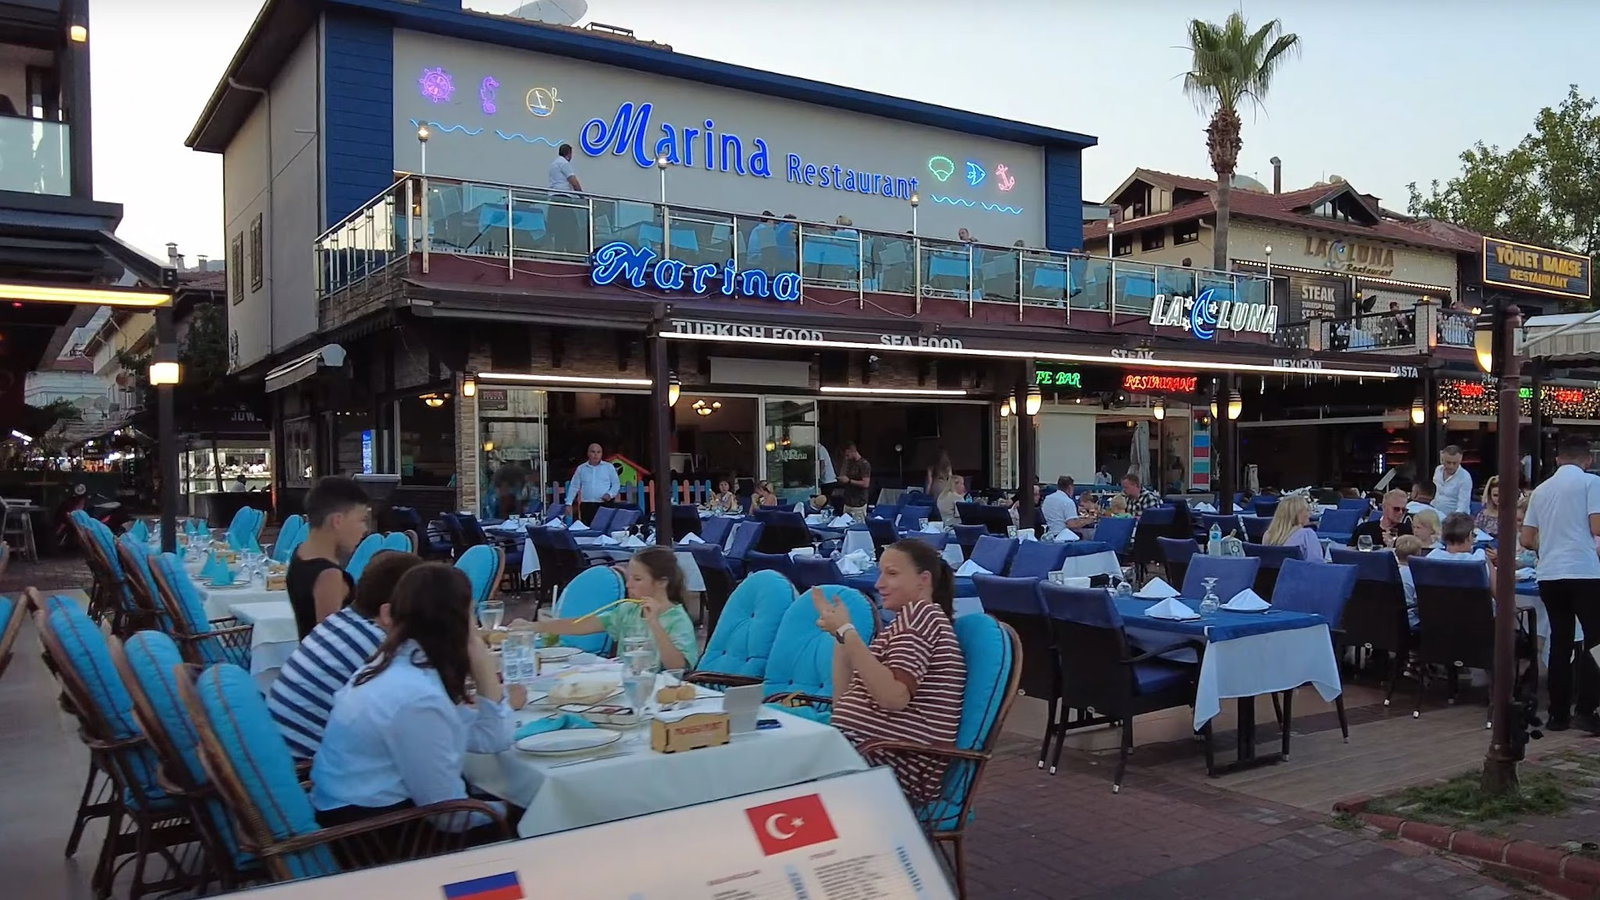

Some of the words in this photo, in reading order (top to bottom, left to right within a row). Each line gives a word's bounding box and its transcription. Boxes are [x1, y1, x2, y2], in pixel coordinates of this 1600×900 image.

[580, 101, 772, 178] Marina
[786, 153, 919, 199] Restaurant
[591, 241, 801, 301] Marina
[1509, 268, 1569, 288] RESTAURANT
[1301, 285, 1335, 302] STEAK
[1149, 294, 1184, 327] LA
[1216, 300, 1279, 334] LUNA
[672, 321, 765, 339] TURKISH
[773, 328, 824, 341] FOOD
[880, 334, 913, 347] SEA
[918, 336, 963, 349] FOOD
[1111, 349, 1155, 360] STEAK
[1056, 371, 1082, 388] BAR
[1390, 366, 1419, 378] PASTA
[1124, 374, 1197, 392] RESTAURANT
